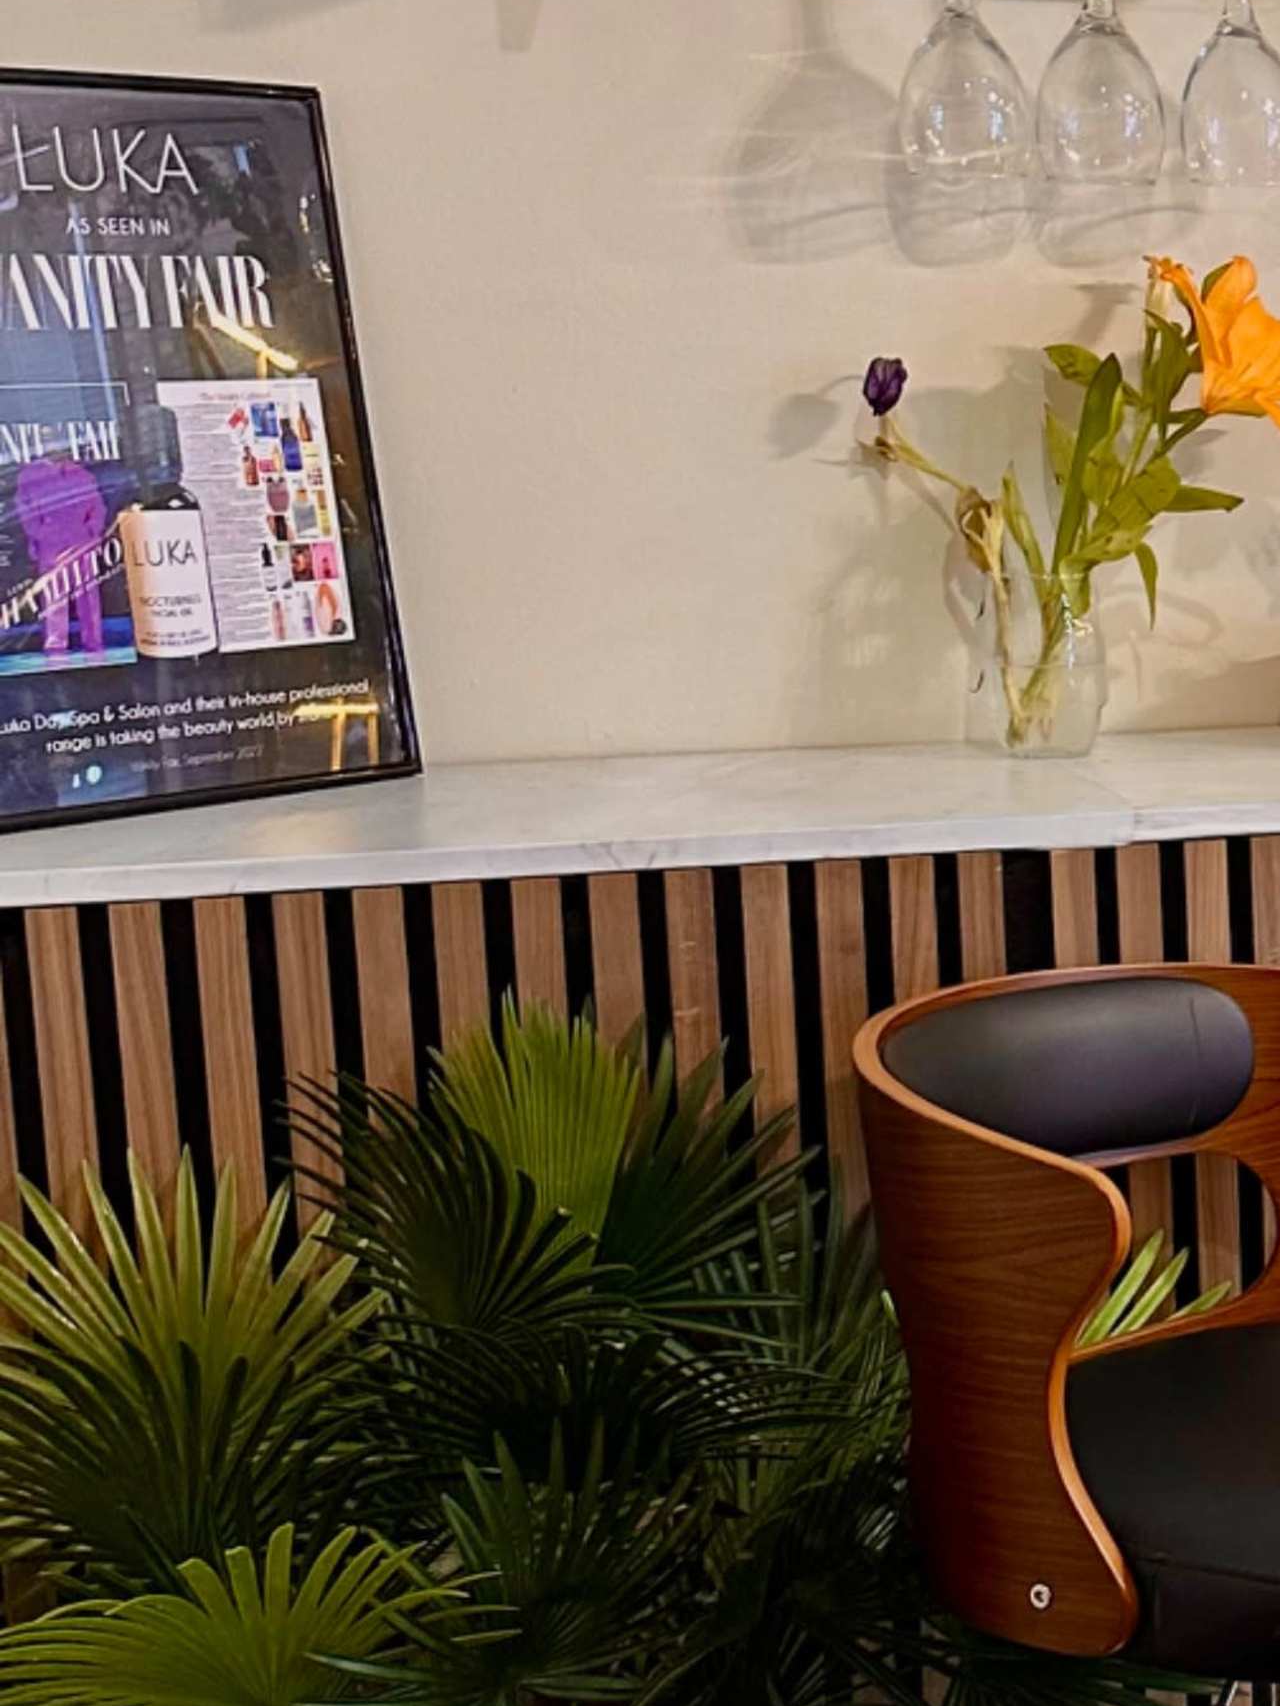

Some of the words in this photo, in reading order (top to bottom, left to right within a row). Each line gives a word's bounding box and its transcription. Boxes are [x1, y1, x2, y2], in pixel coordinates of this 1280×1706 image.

[12, 123, 200, 195] LUKA
[65, 218, 91, 235] AS
[97, 217, 145, 235] SEEN
[150, 217, 171, 236] IN
[0, 253, 152, 330] ANITY
[160, 255, 275, 329] FAIR
[132, 539, 199, 567] LUKA
[118, 702, 162, 720] Salon
[164, 697, 193, 716] and
[195, 695, 226, 712] their
[228, 690, 288, 708] in-house
[289, 678, 370, 703] professional
[46, 736, 92, 753] range
[95, 734, 107, 748] is
[109, 728, 156, 746] taking
[157, 724, 181, 739] the
[184, 717, 234, 738] beauty
[236, 711, 275, 730] world
[277, 710, 295, 727] by
